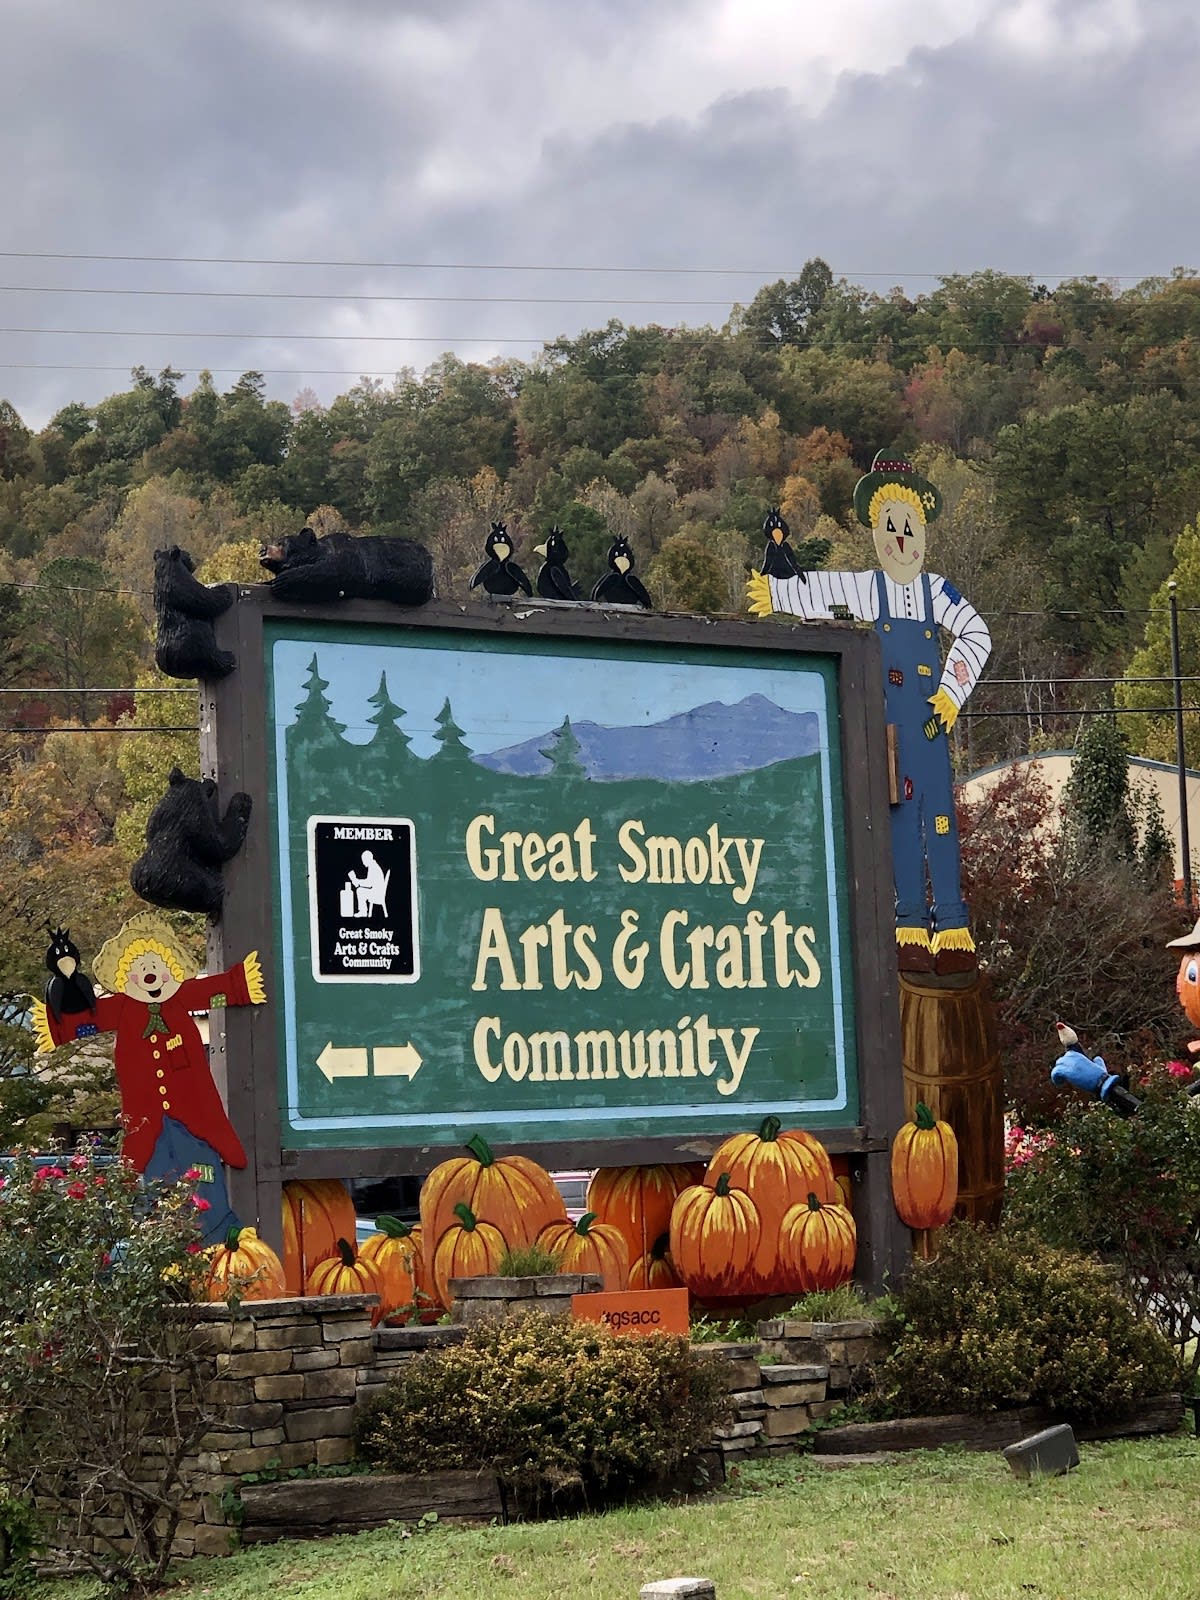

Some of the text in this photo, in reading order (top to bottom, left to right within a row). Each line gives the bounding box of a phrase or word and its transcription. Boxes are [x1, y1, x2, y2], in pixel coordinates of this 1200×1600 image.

[333, 826, 394, 841] MEMBER
[465, 814, 764, 906] Great Smoky
[338, 927, 394, 941] Great Smoky
[333, 941, 400, 956] Arts & Crafts
[471, 907, 821, 991] Arts & Crafts
[342, 955, 393, 970] Community
[472, 1014, 760, 1095] Community
